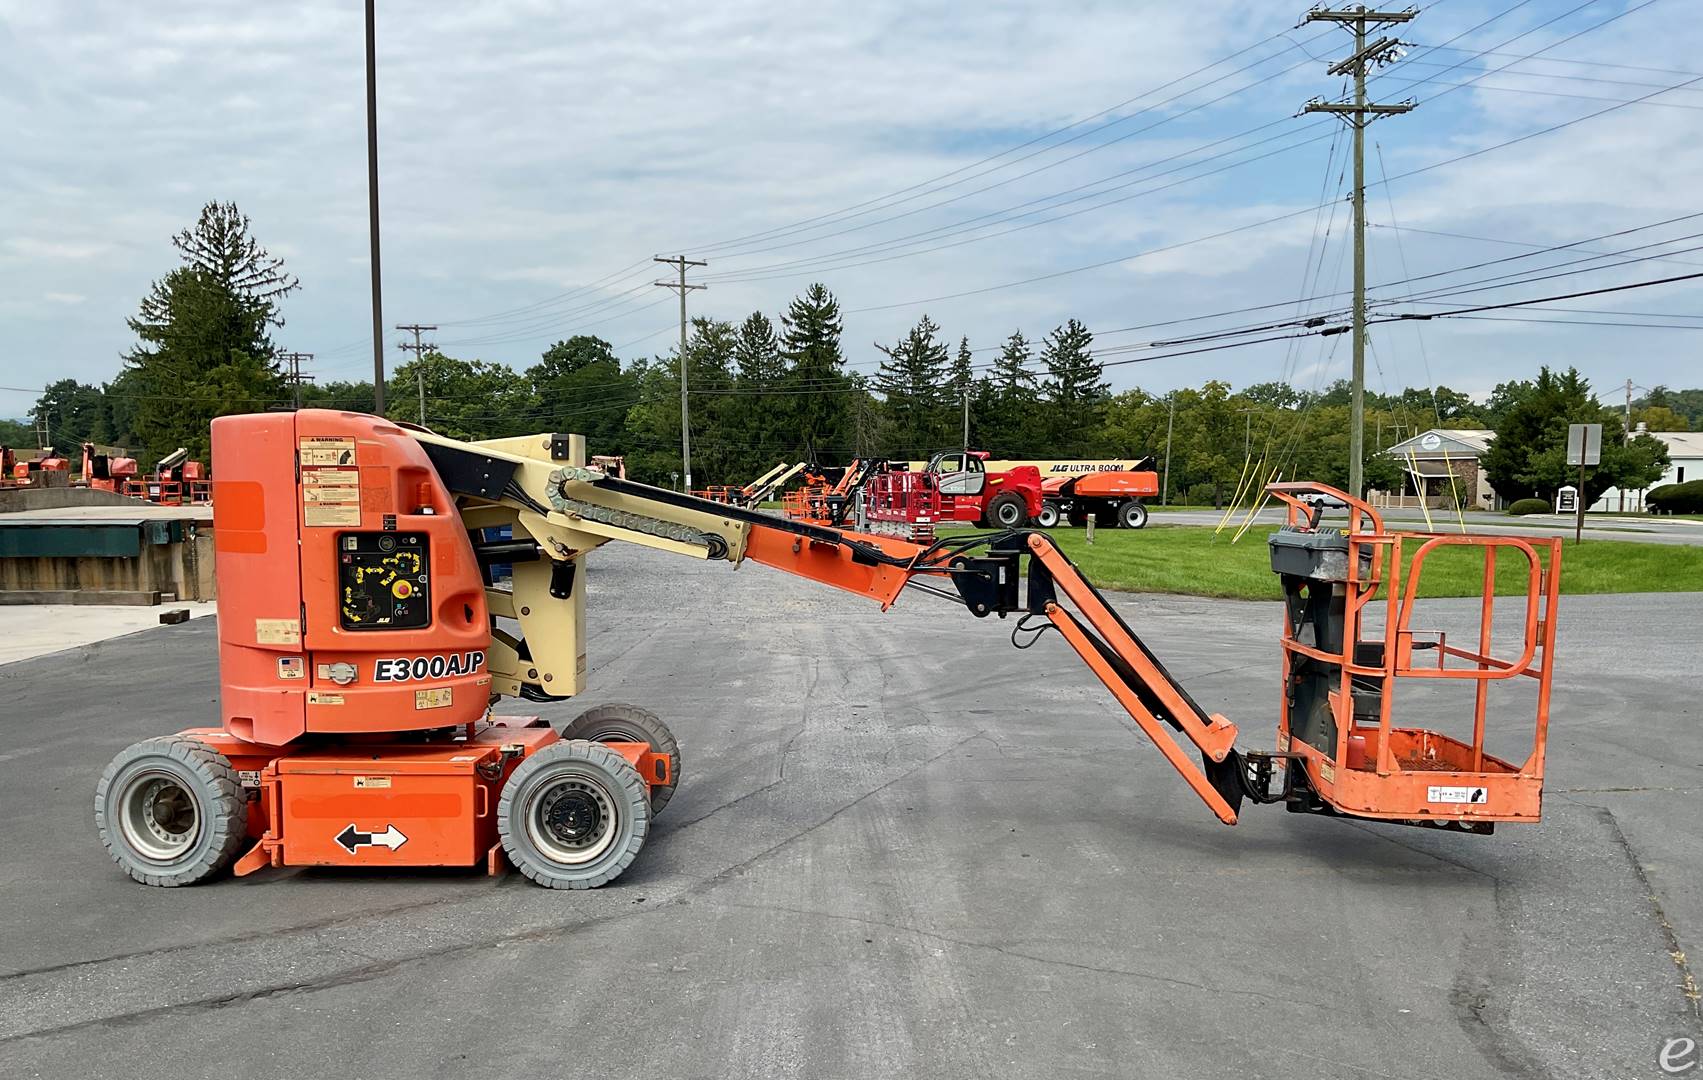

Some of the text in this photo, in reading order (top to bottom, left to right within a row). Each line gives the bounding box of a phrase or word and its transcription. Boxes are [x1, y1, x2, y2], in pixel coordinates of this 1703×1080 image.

[1050, 464, 1124, 472] JLG ULTRA BOOM
[374, 651, 485, 682] E300AJP
